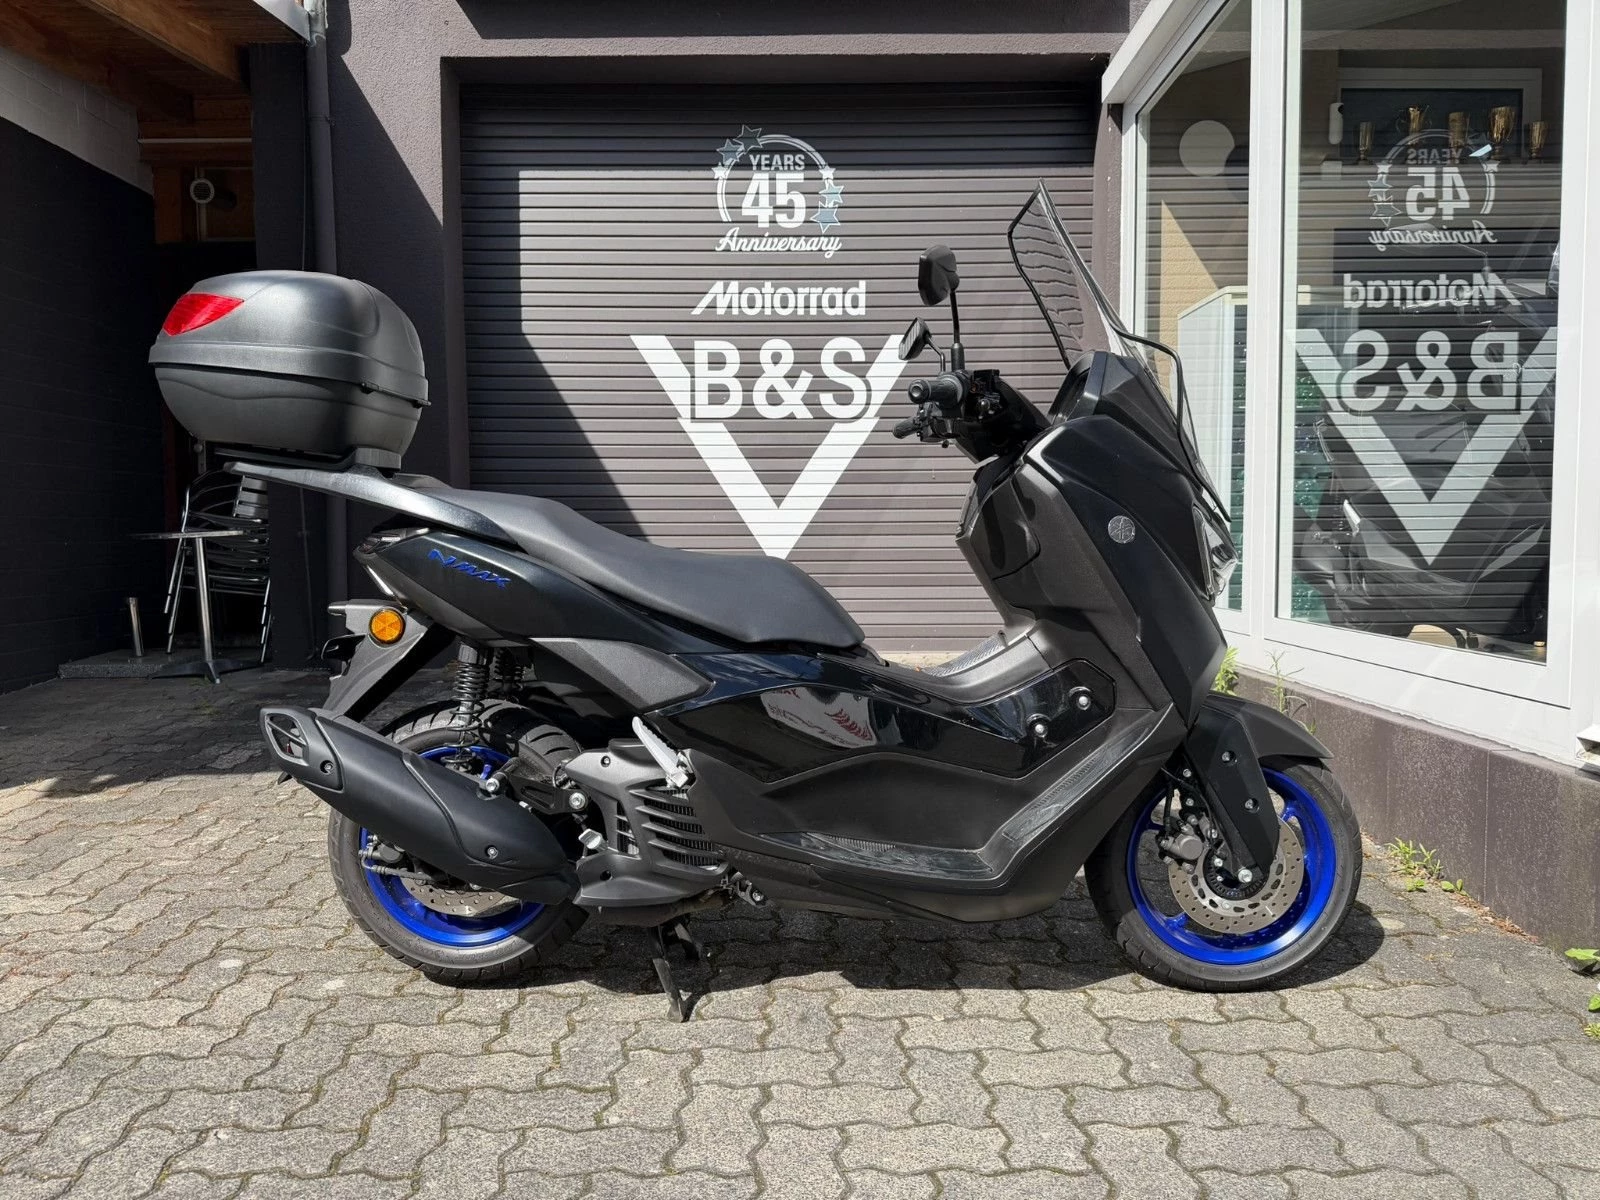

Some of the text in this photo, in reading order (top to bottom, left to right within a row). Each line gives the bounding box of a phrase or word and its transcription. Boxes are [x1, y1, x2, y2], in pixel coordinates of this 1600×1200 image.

[749, 154, 805, 171] YEARS
[741, 172, 805, 228] 45
[715, 227, 842, 258] Anniversary
[691, 280, 866, 315] Motorrad
[693, 337, 868, 419] B&S
[428, 548, 511, 591] NMAX
